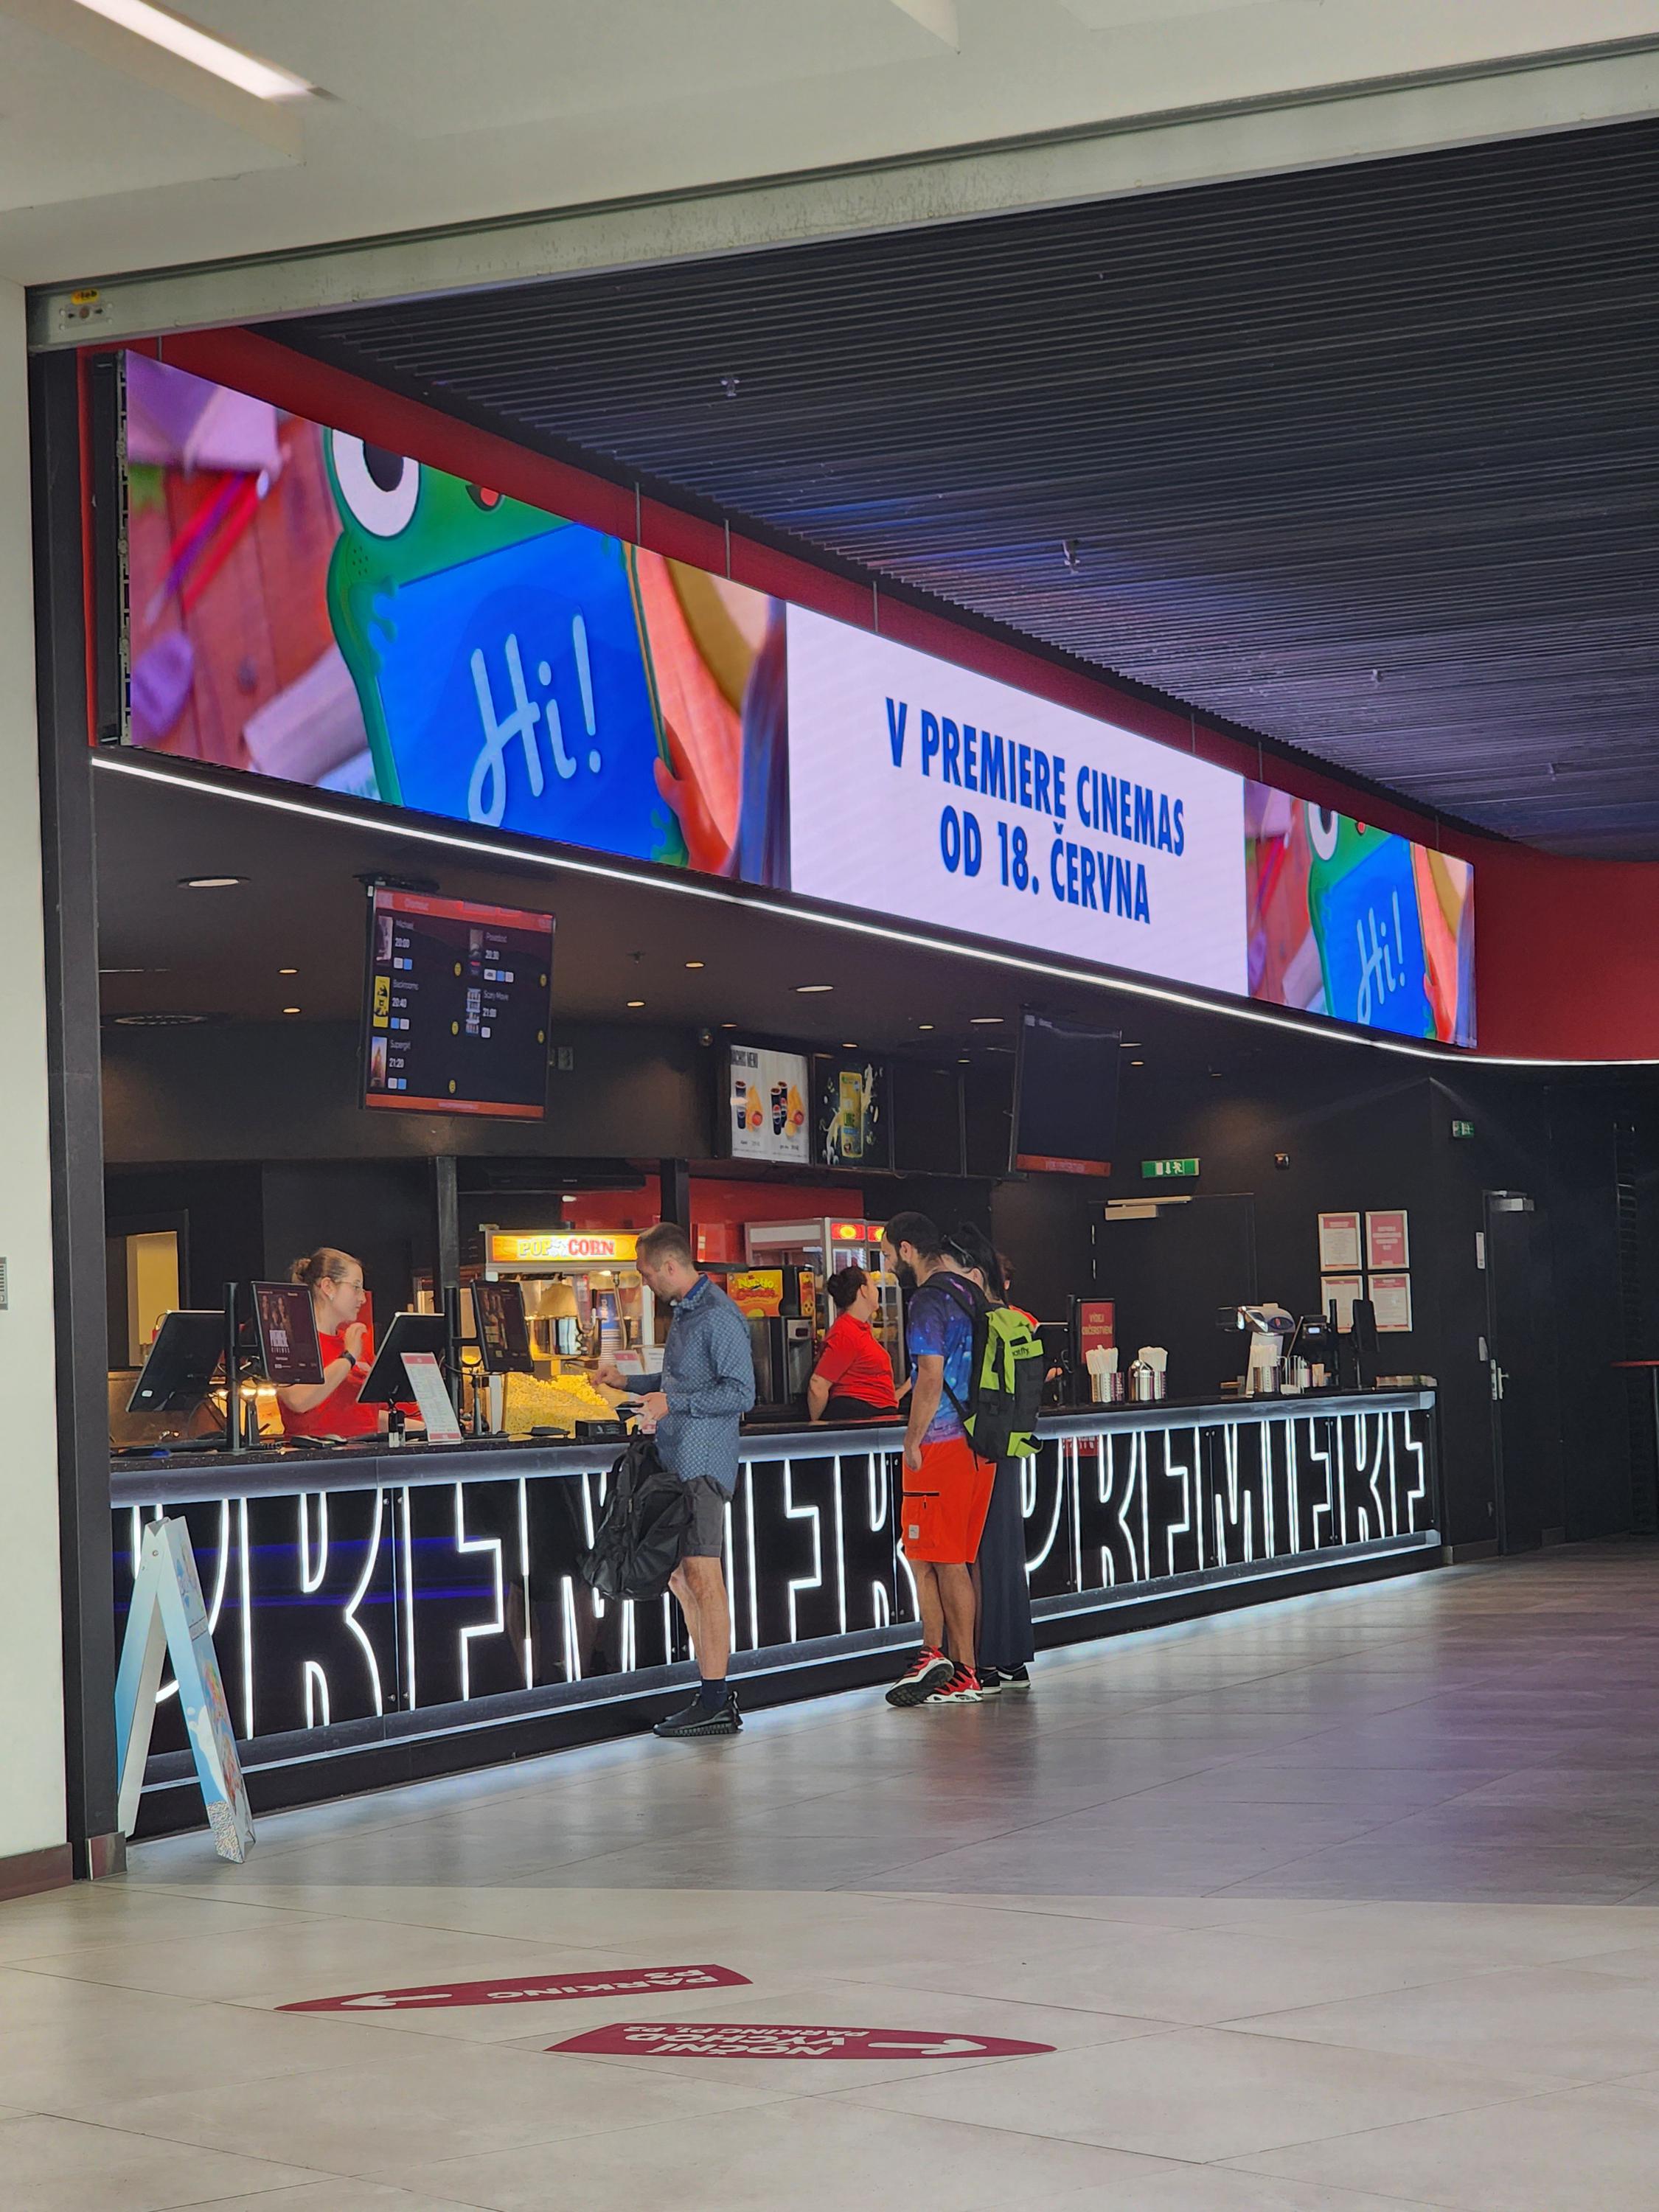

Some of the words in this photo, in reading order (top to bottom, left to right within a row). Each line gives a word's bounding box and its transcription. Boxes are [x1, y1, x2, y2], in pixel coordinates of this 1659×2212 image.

[467, 615, 602, 827] Hi!
[886, 697, 908, 768] V
[921, 709, 1067, 820] PREMIERE
[1077, 765, 1185, 857] CINEMAS
[940, 805, 982, 877] OD
[998, 821, 1040, 895] 18.
[1050, 821, 1151, 925] ČERVNA
[1356, 891, 1405, 1026] Hi!
[519, 1239, 552, 1256] POP
[568, 1238, 614, 1256] CORN
[1020, 1410, 1425, 1593] PREMIERE
[643, 1969, 706, 1980] P3
[487, 1975, 719, 2000] PARKING
[624, 2033, 846, 2045] VÝCHOD
[717, 2028, 871, 2037] PARKING
[644, 2042, 834, 2056] NOČNÍ
